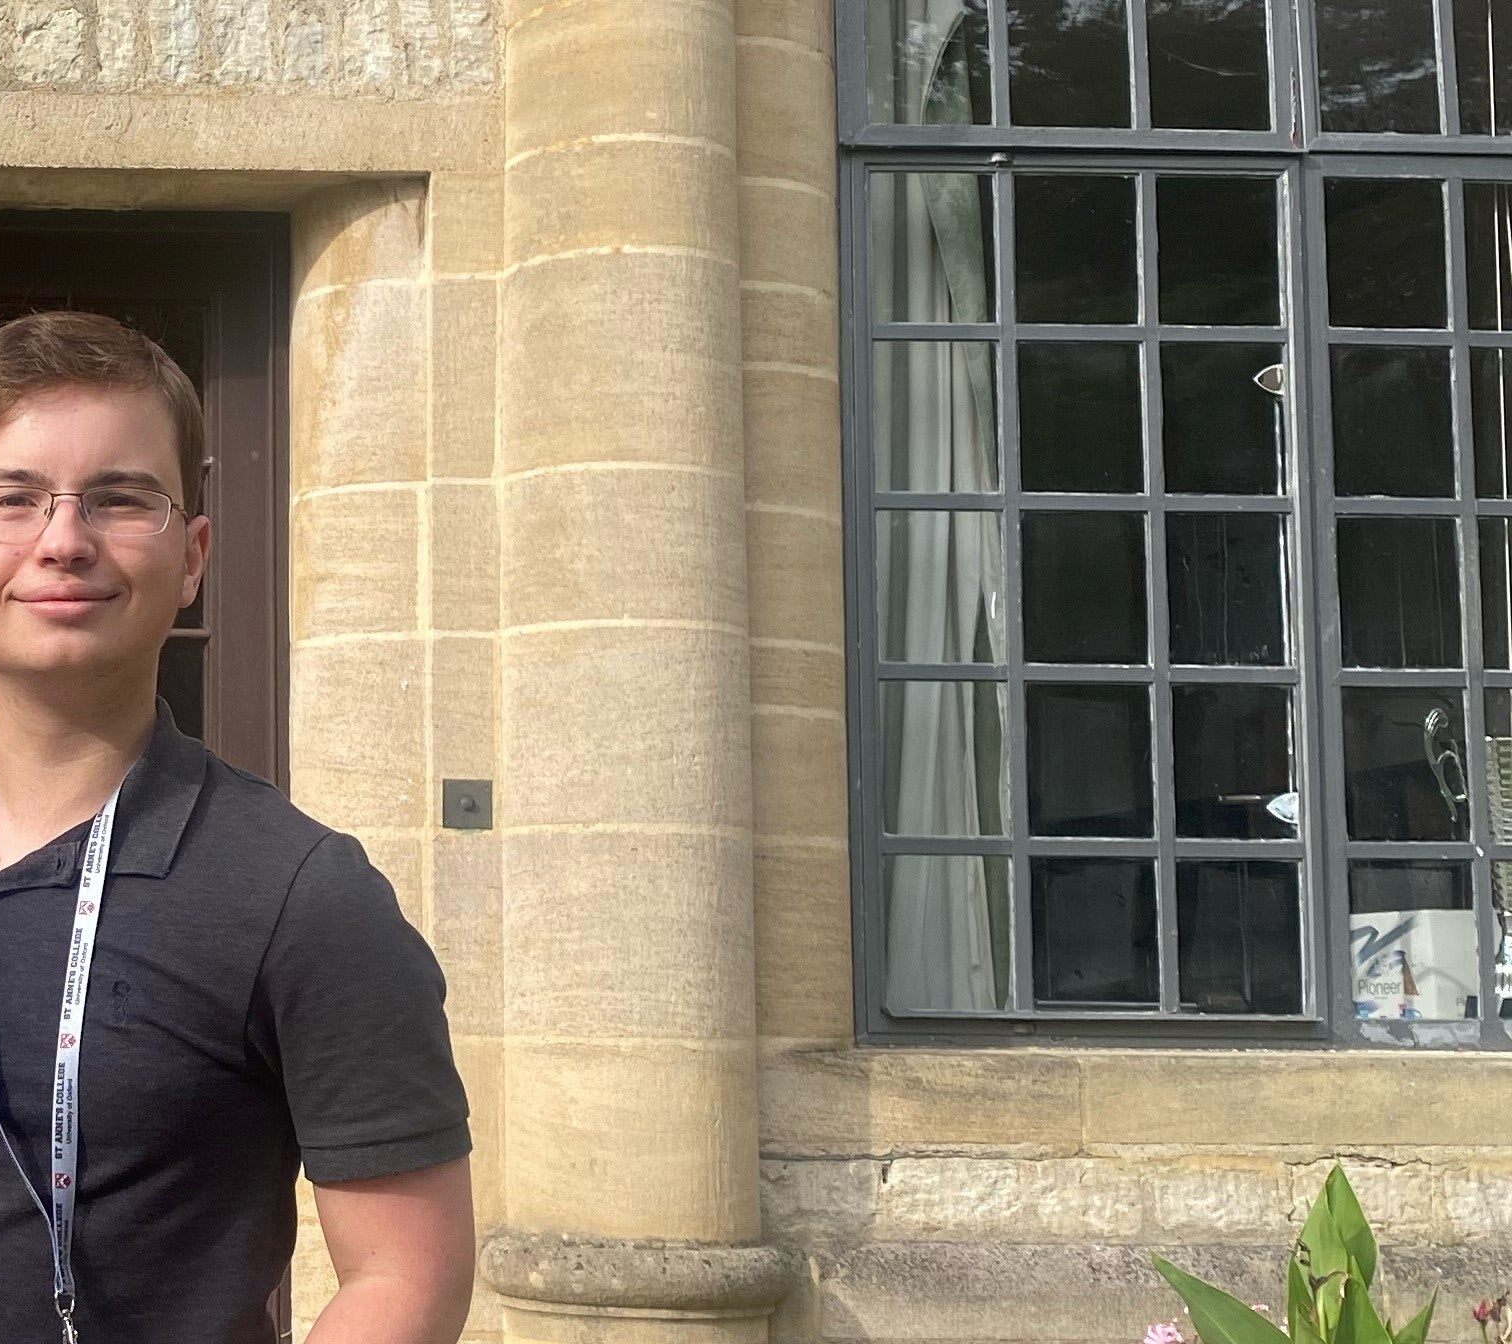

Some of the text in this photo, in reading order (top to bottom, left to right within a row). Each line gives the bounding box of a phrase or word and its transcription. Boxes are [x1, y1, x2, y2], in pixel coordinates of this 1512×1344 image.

[70, 927, 83, 968] COLLEGE
[1357, 978, 1402, 996] Pioneer
[55, 1062, 66, 1105] COLLEGE
[65, 1111, 73, 1144] University
[54, 1146, 63, 1159] ST
